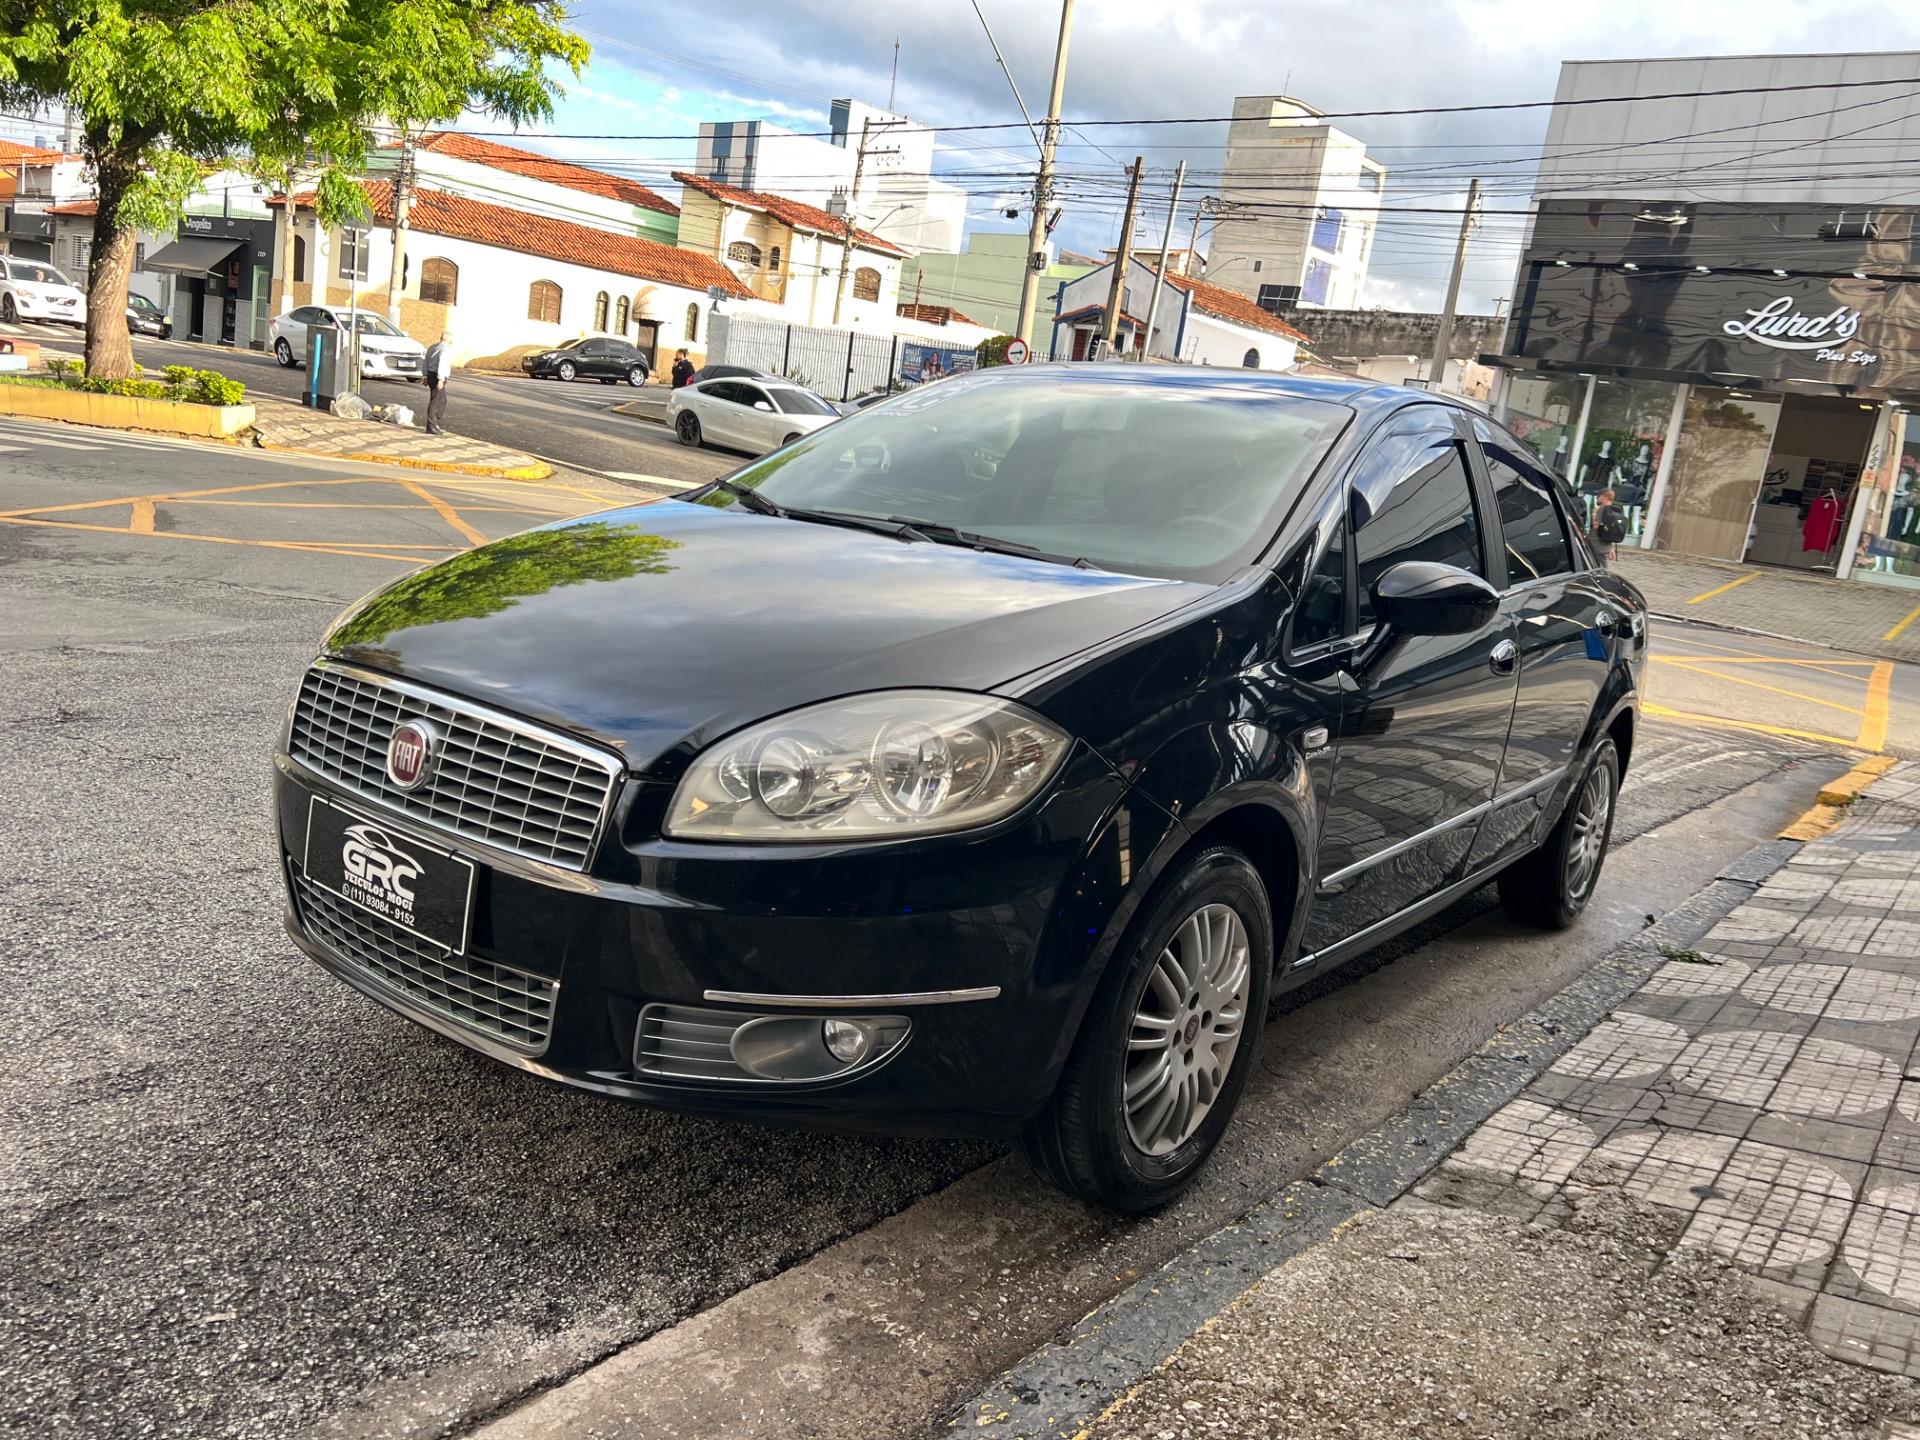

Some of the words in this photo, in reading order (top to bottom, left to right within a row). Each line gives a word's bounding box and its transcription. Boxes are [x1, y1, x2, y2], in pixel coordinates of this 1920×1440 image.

[1722, 296, 1861, 350] Lurd's
[1815, 348, 1846, 362] Plus
[1847, 350, 1878, 366] Size
[394, 740, 421, 774] FIAT
[342, 840, 417, 902] GRC
[343, 869, 385, 898] VEICULOS
[386, 891, 413, 912] MOGI
[351, 886, 365, 905] (11)
[366, 894, 389, 914] 93084
[394, 908, 415, 927] 9152
